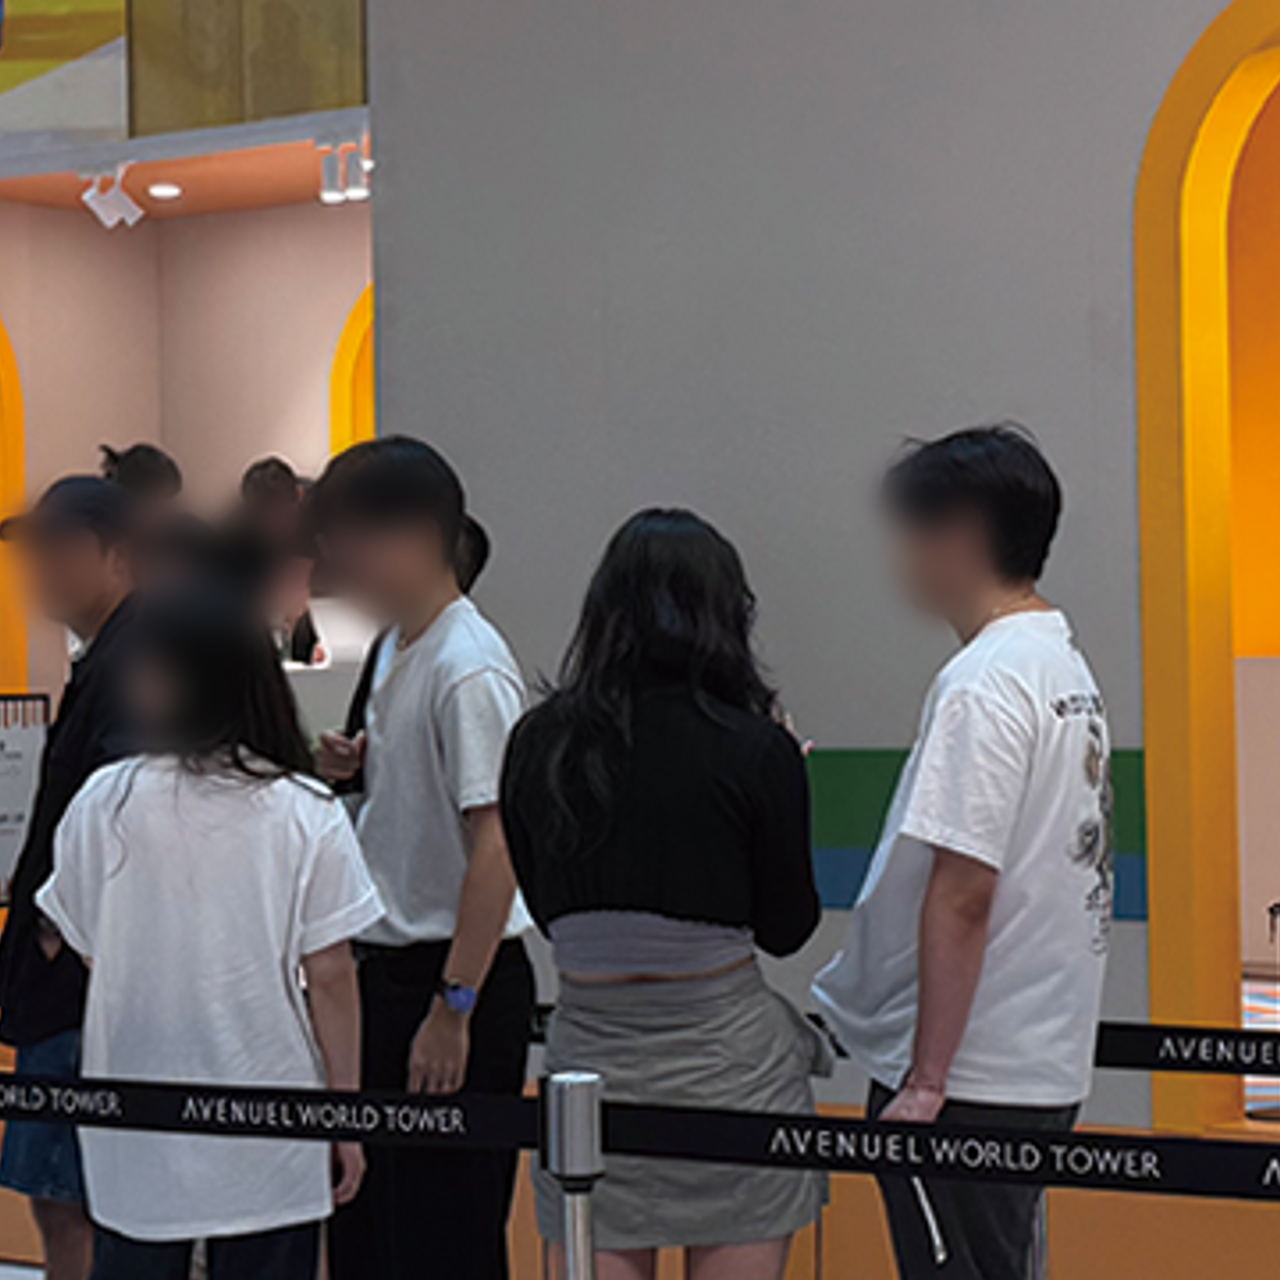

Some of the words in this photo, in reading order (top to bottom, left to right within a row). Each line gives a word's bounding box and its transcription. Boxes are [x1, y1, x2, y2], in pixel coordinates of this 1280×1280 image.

[50, 1087, 122, 1116] TOWER
[182, 1097, 291, 1128] AVENUEL
[296, 1103, 378, 1130] WORLD
[385, 1106, 465, 1133] TOWER
[770, 1128, 921, 1163] AVENUEL
[931, 1137, 1040, 1171] WORLD
[1050, 1145, 1161, 1179] TOWER
